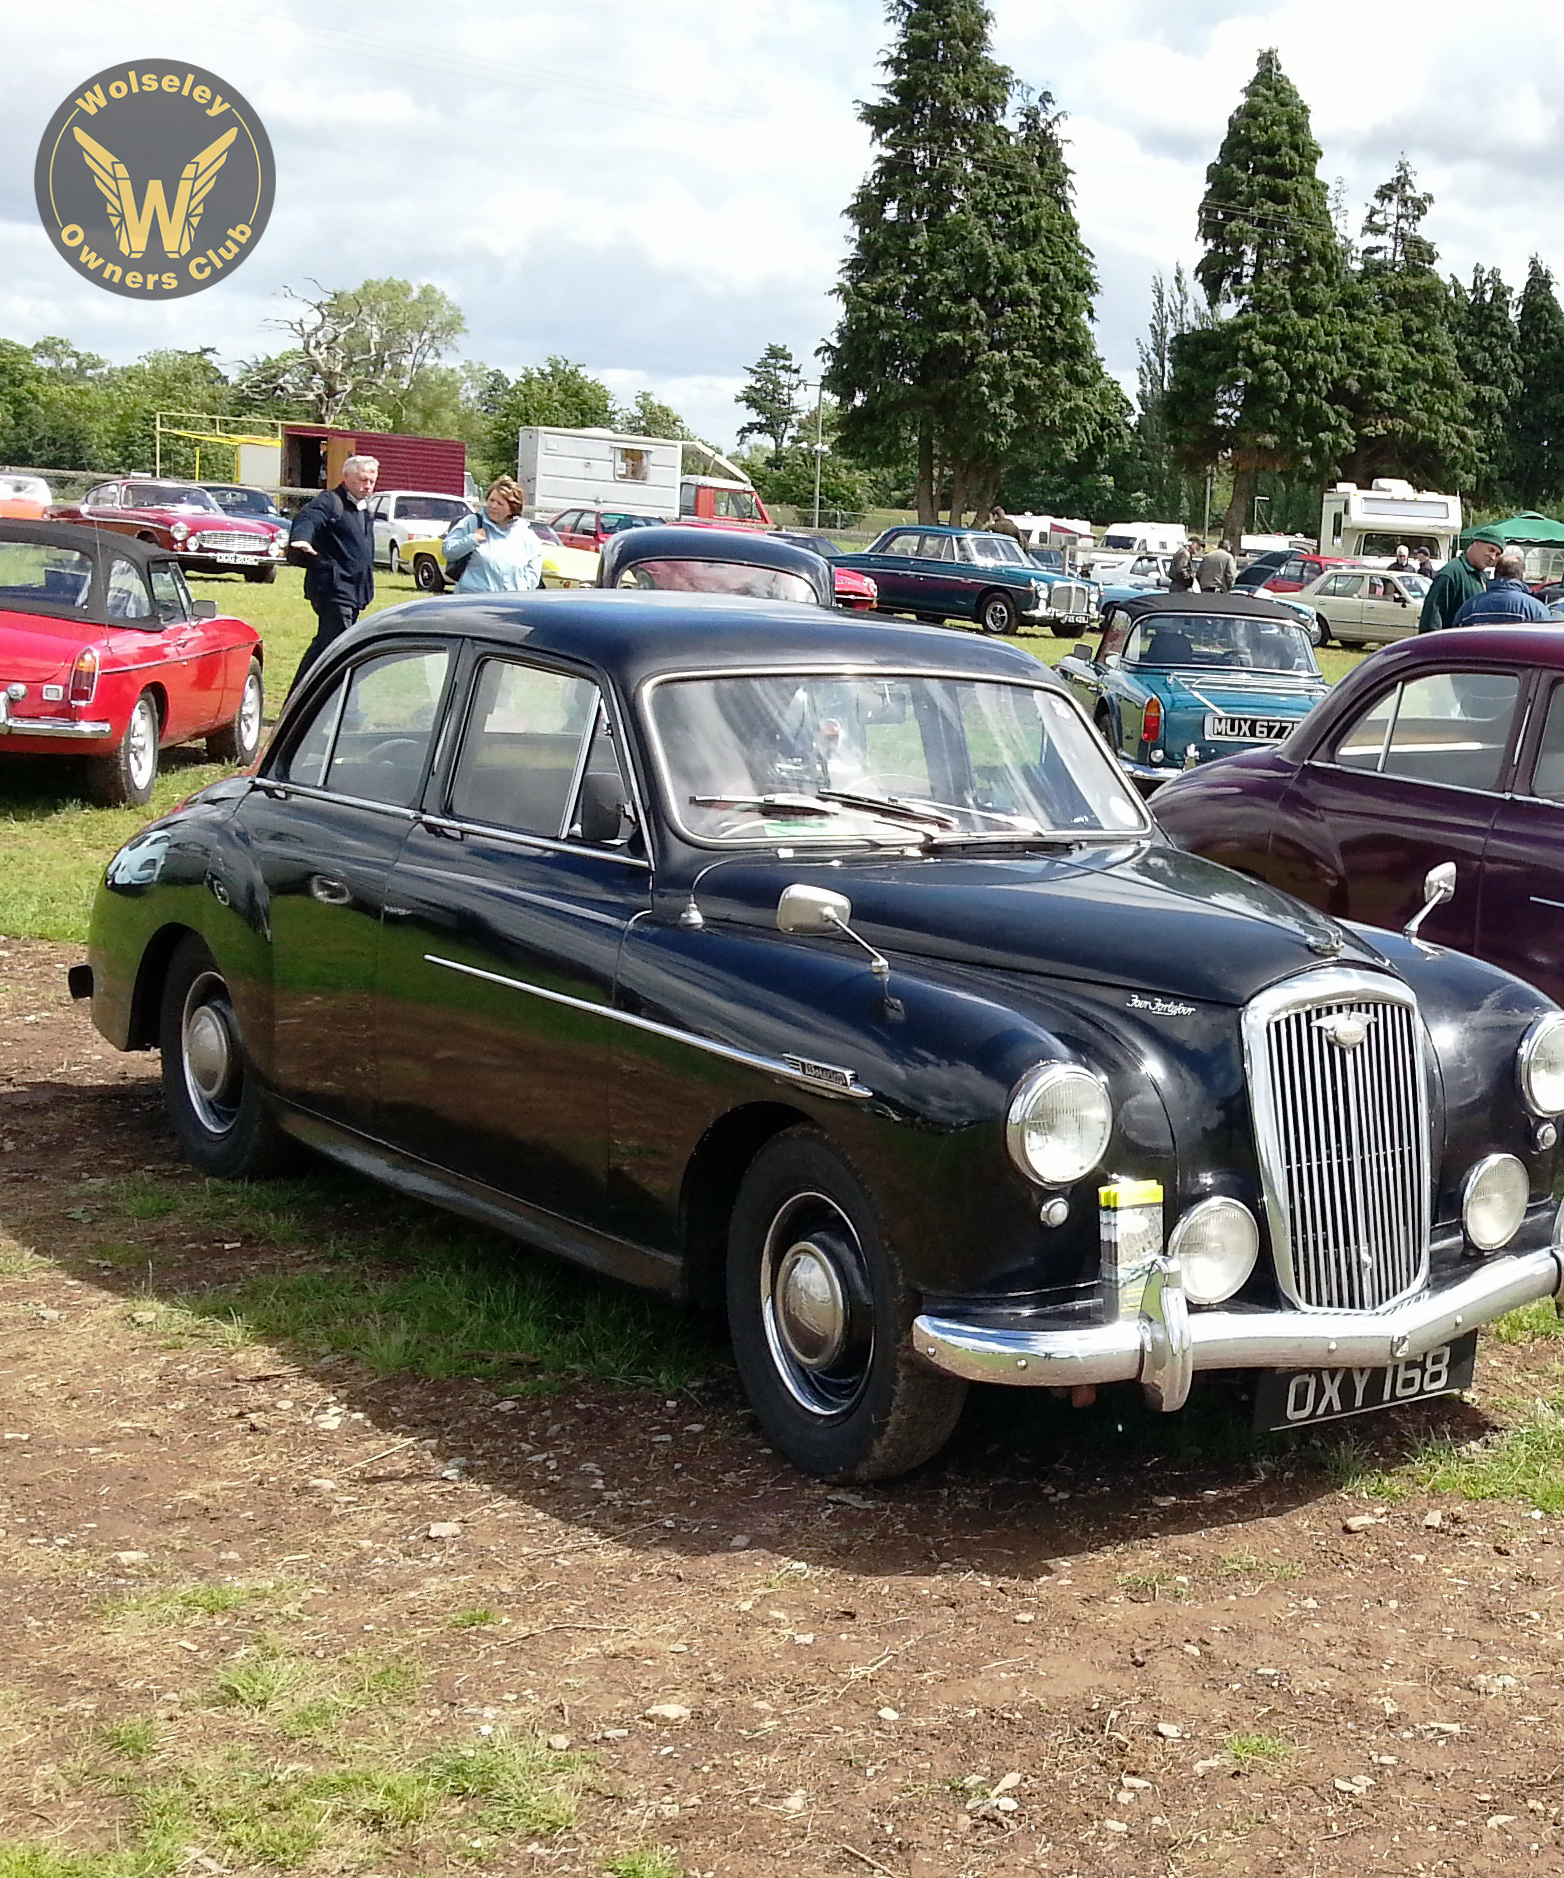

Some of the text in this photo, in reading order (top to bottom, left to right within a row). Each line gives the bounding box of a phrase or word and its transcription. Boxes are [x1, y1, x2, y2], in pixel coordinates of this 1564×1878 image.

[1213, 718, 1252, 737] MUX
[1285, 1346, 1451, 1421] OXY 168
